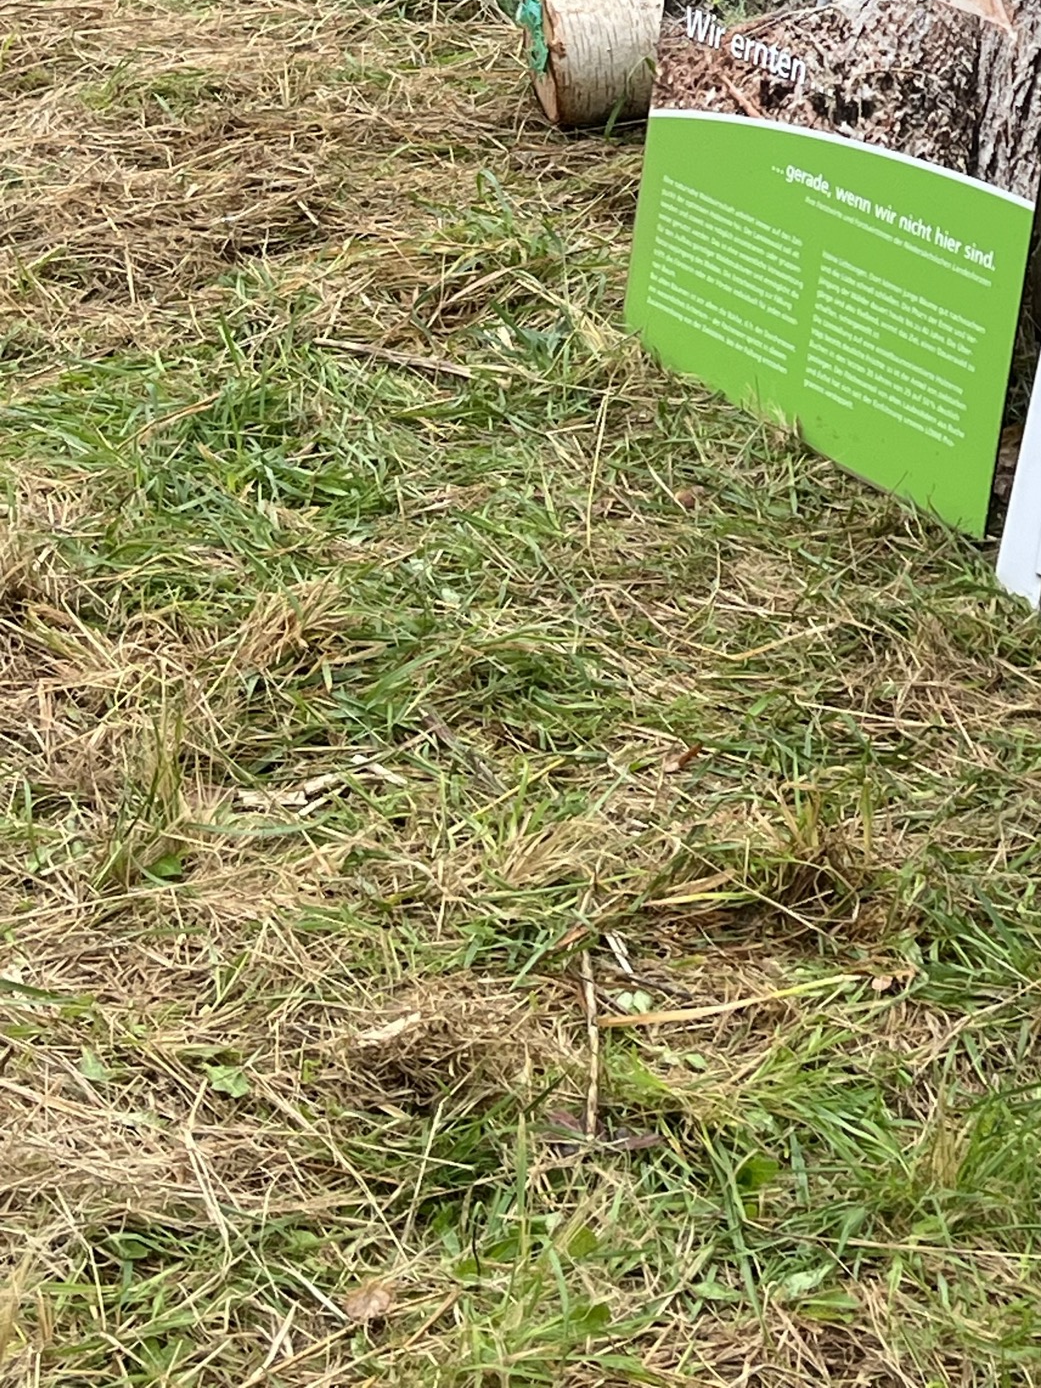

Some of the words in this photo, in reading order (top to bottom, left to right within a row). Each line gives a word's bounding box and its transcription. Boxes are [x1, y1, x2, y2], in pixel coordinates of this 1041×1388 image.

[686, 6, 724, 50] Wir
[836, 187, 871, 213] wenn
[875, 204, 897, 224] wir
[899, 215, 932, 241] nicht
[935, 227, 961, 253] hier
[964, 243, 995, 271] sind.
